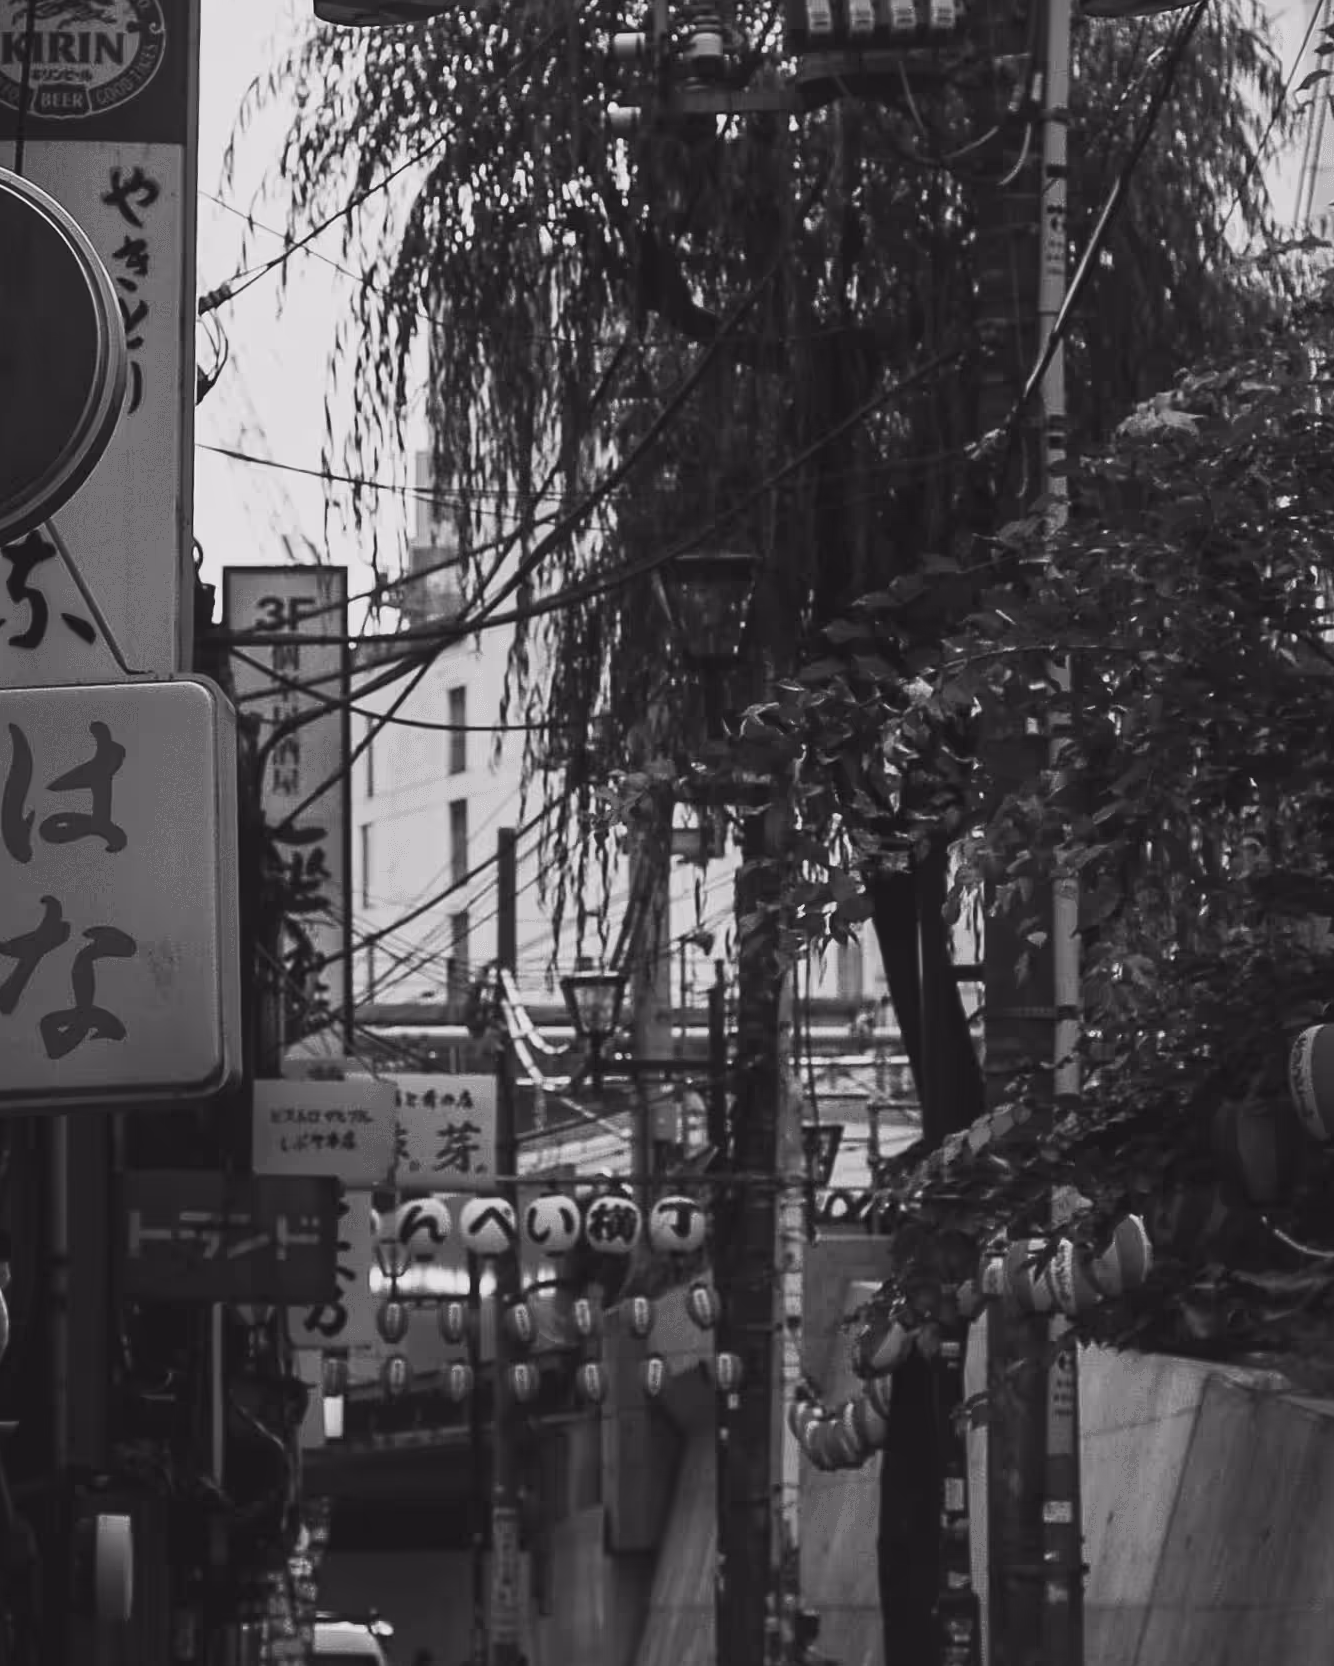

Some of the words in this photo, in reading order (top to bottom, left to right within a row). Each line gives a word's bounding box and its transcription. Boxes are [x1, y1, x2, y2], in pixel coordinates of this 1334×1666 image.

[2, 31, 126, 65] KIRIN
[40, 92, 84, 109] BEER
[254, 596, 316, 631] 3F
